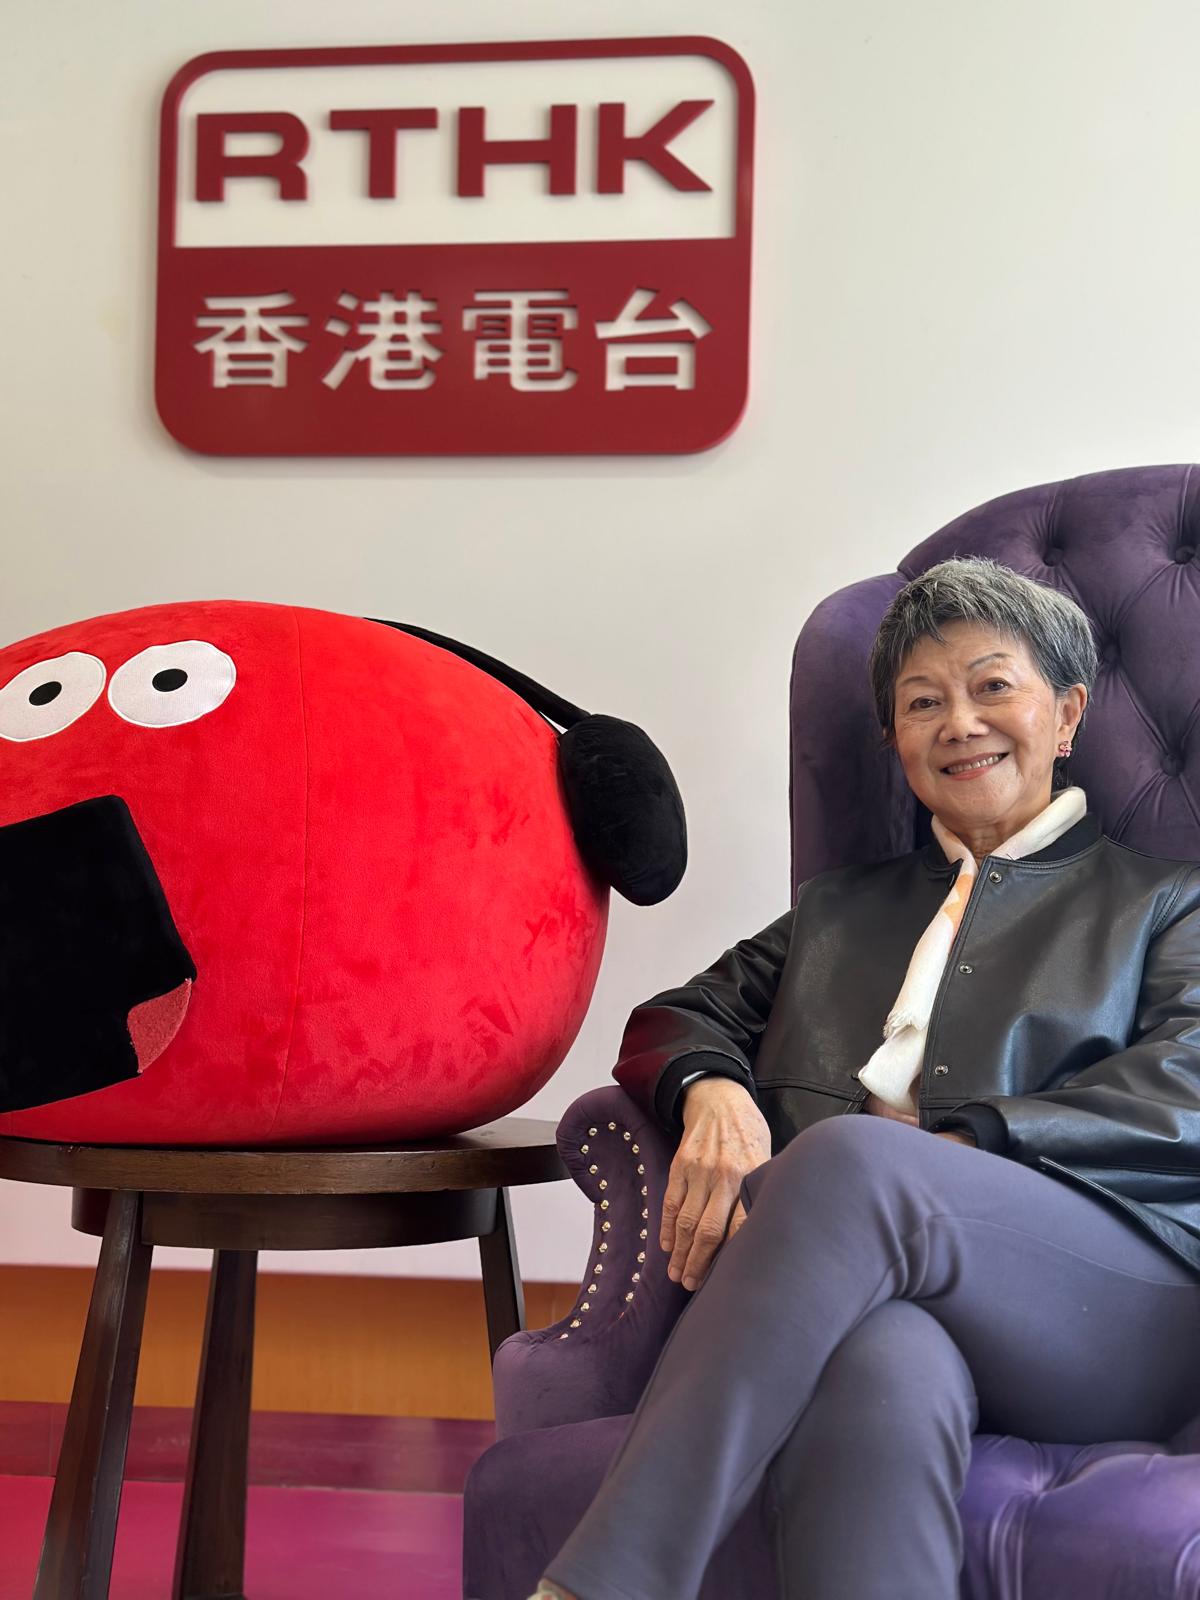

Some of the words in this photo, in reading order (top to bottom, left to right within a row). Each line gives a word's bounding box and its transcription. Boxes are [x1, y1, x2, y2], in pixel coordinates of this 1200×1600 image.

[196, 99, 714, 202] RTHK
[193, 286, 713, 392] 香港電台
